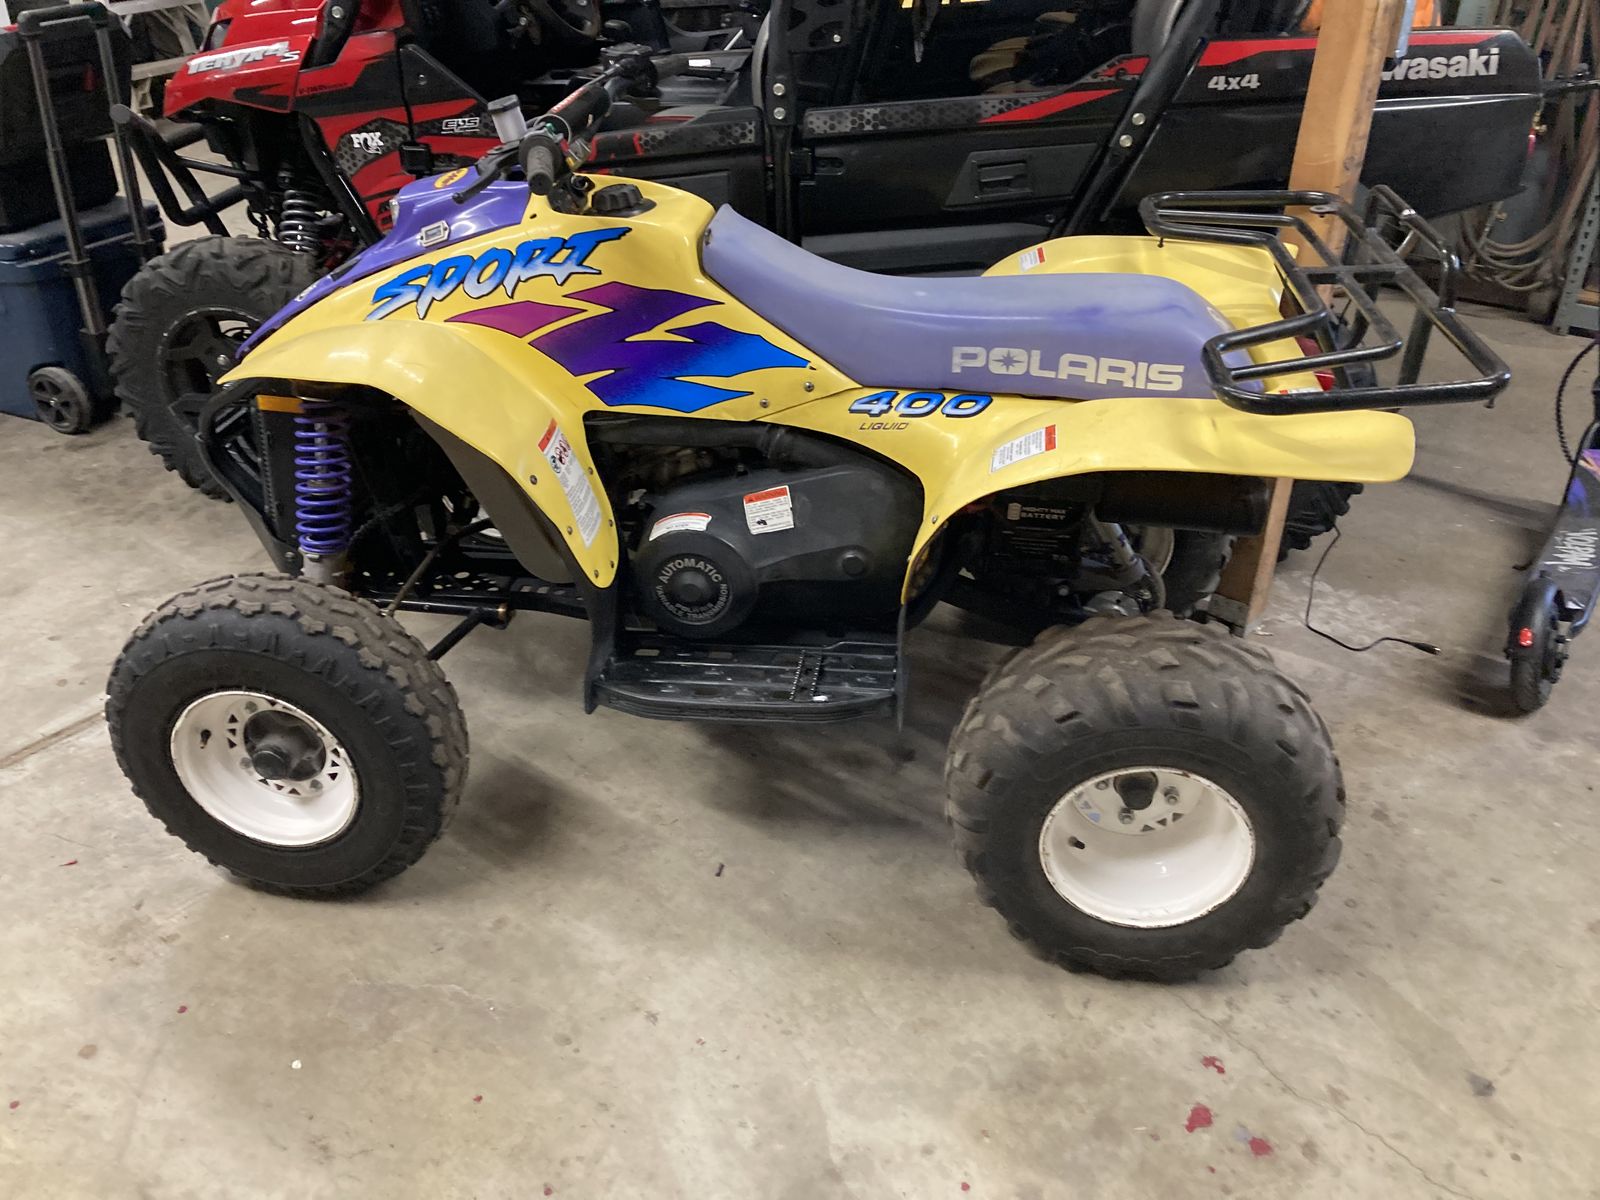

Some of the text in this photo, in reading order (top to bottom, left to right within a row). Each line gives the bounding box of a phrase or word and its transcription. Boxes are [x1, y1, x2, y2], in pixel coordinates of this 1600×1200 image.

[1207, 73, 1261, 91] 4x4
[351, 132, 384, 154] FOX
[363, 226, 632, 320] SPORT
[951, 346, 1185, 392] POLARIS
[848, 390, 994, 418] 400
[859, 422, 910, 431] LIQUID
[658, 558, 722, 584] AUTOMATIC
